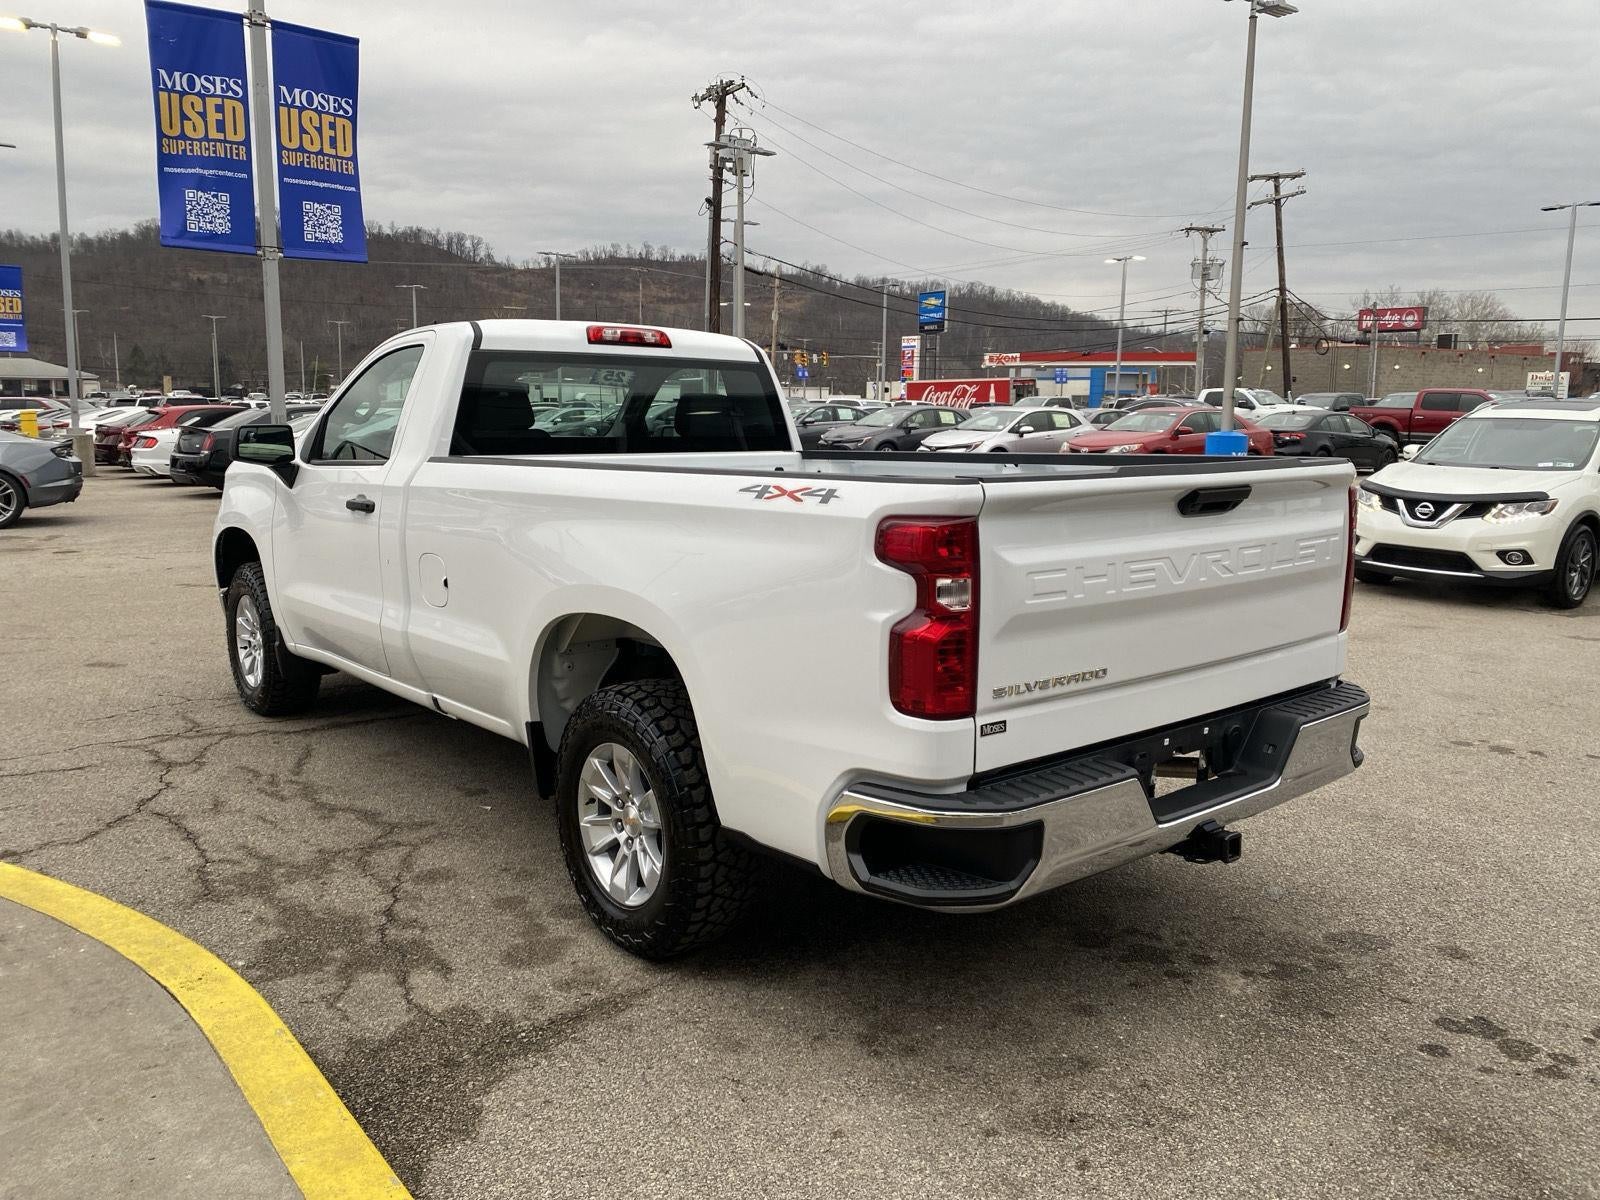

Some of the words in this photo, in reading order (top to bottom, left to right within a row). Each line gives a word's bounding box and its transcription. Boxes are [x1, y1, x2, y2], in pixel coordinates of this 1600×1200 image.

[157, 68, 243, 98] MOSES
[279, 85, 353, 117] MOSES
[159, 91, 246, 142] USED
[279, 106, 353, 158] USED
[162, 138, 247, 161] SUPERCENTER
[282, 149, 355, 175] SUPERCENTER
[163, 166, 248, 179] mosesusedsupercenter.com
[283, 177, 357, 192] mosesusedsupercenter.com
[0, 297, 22, 313] SED
[988, 353, 1018, 365] EXXON
[1025, 534, 1340, 604] CHEVROLET
[992, 668, 1108, 699] SILVERADO
